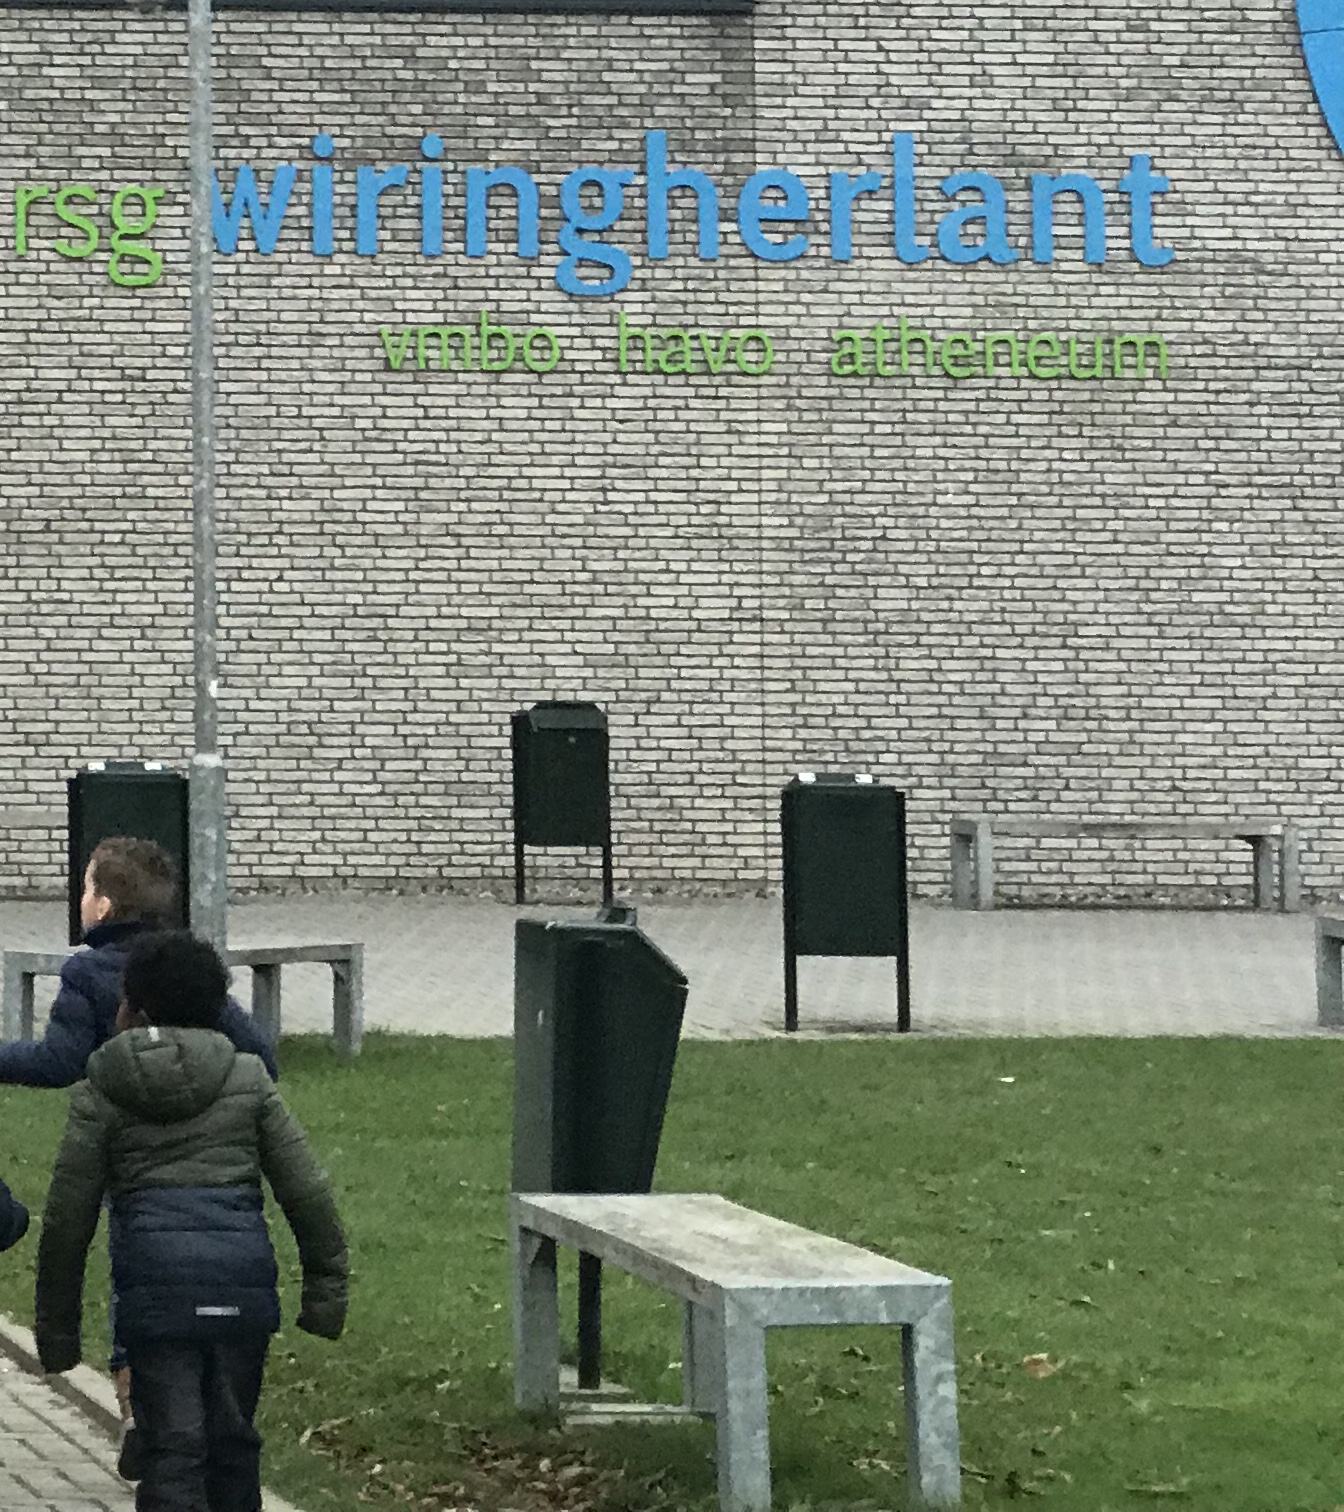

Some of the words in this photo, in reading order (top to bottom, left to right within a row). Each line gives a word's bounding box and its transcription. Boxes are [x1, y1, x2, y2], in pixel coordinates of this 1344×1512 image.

[14, 182, 164, 288] rsg
[211, 130, 1175, 297] wiringherlant
[381, 311, 562, 376] vmbo
[617, 313, 776, 377] havo
[830, 317, 1170, 381] atheneum
